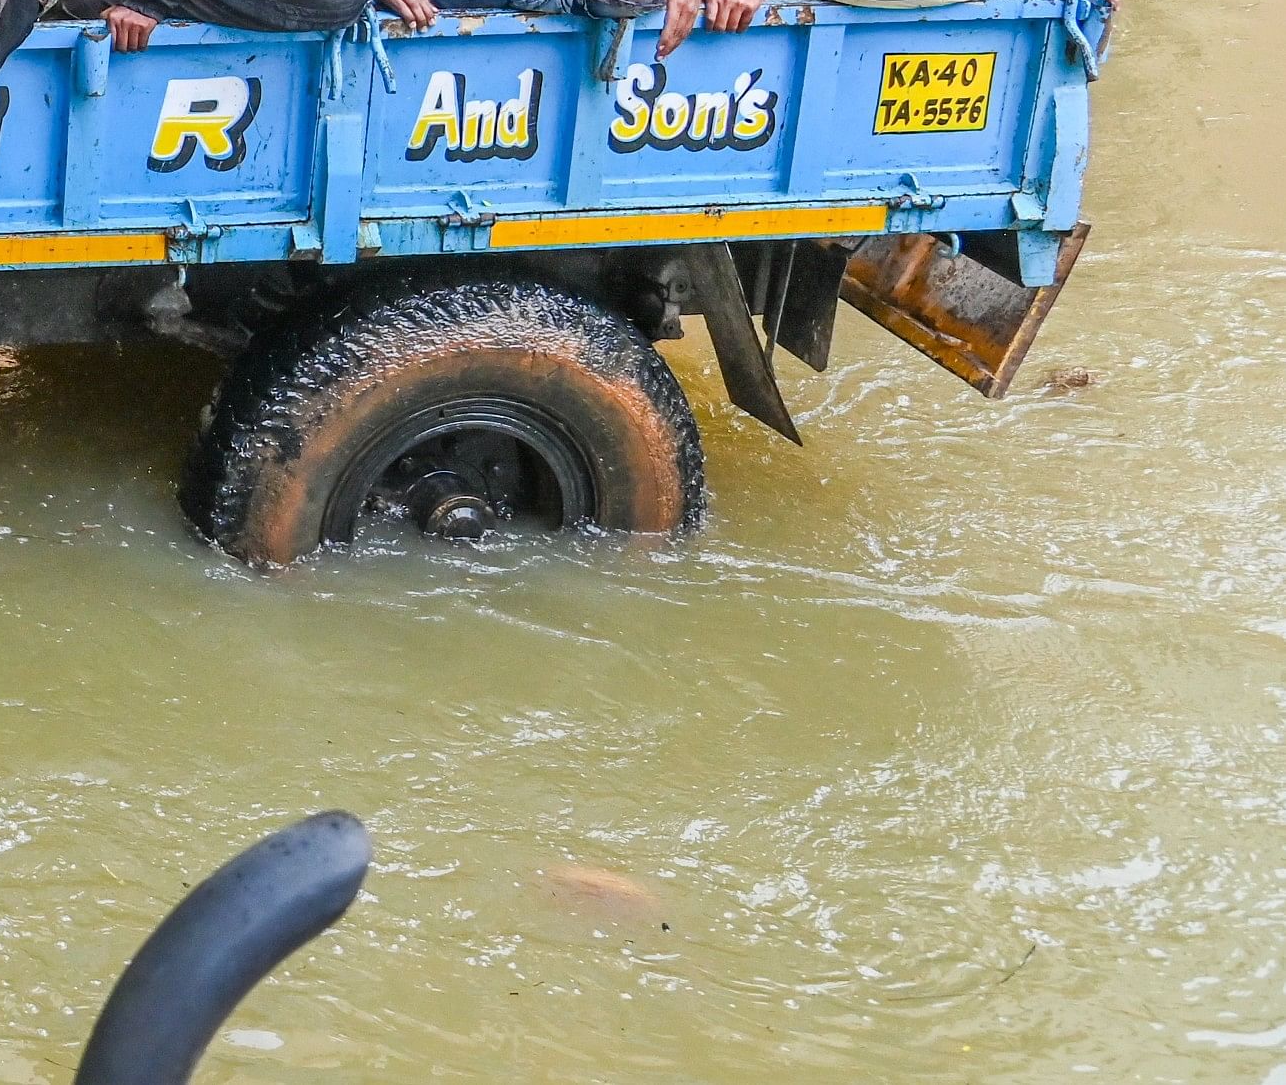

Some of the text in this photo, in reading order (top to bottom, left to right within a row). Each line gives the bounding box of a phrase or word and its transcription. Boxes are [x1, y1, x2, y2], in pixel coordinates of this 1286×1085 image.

[149, 76, 256, 167] R
[406, 68, 538, 157] And
[608, 62, 774, 149] Son's
